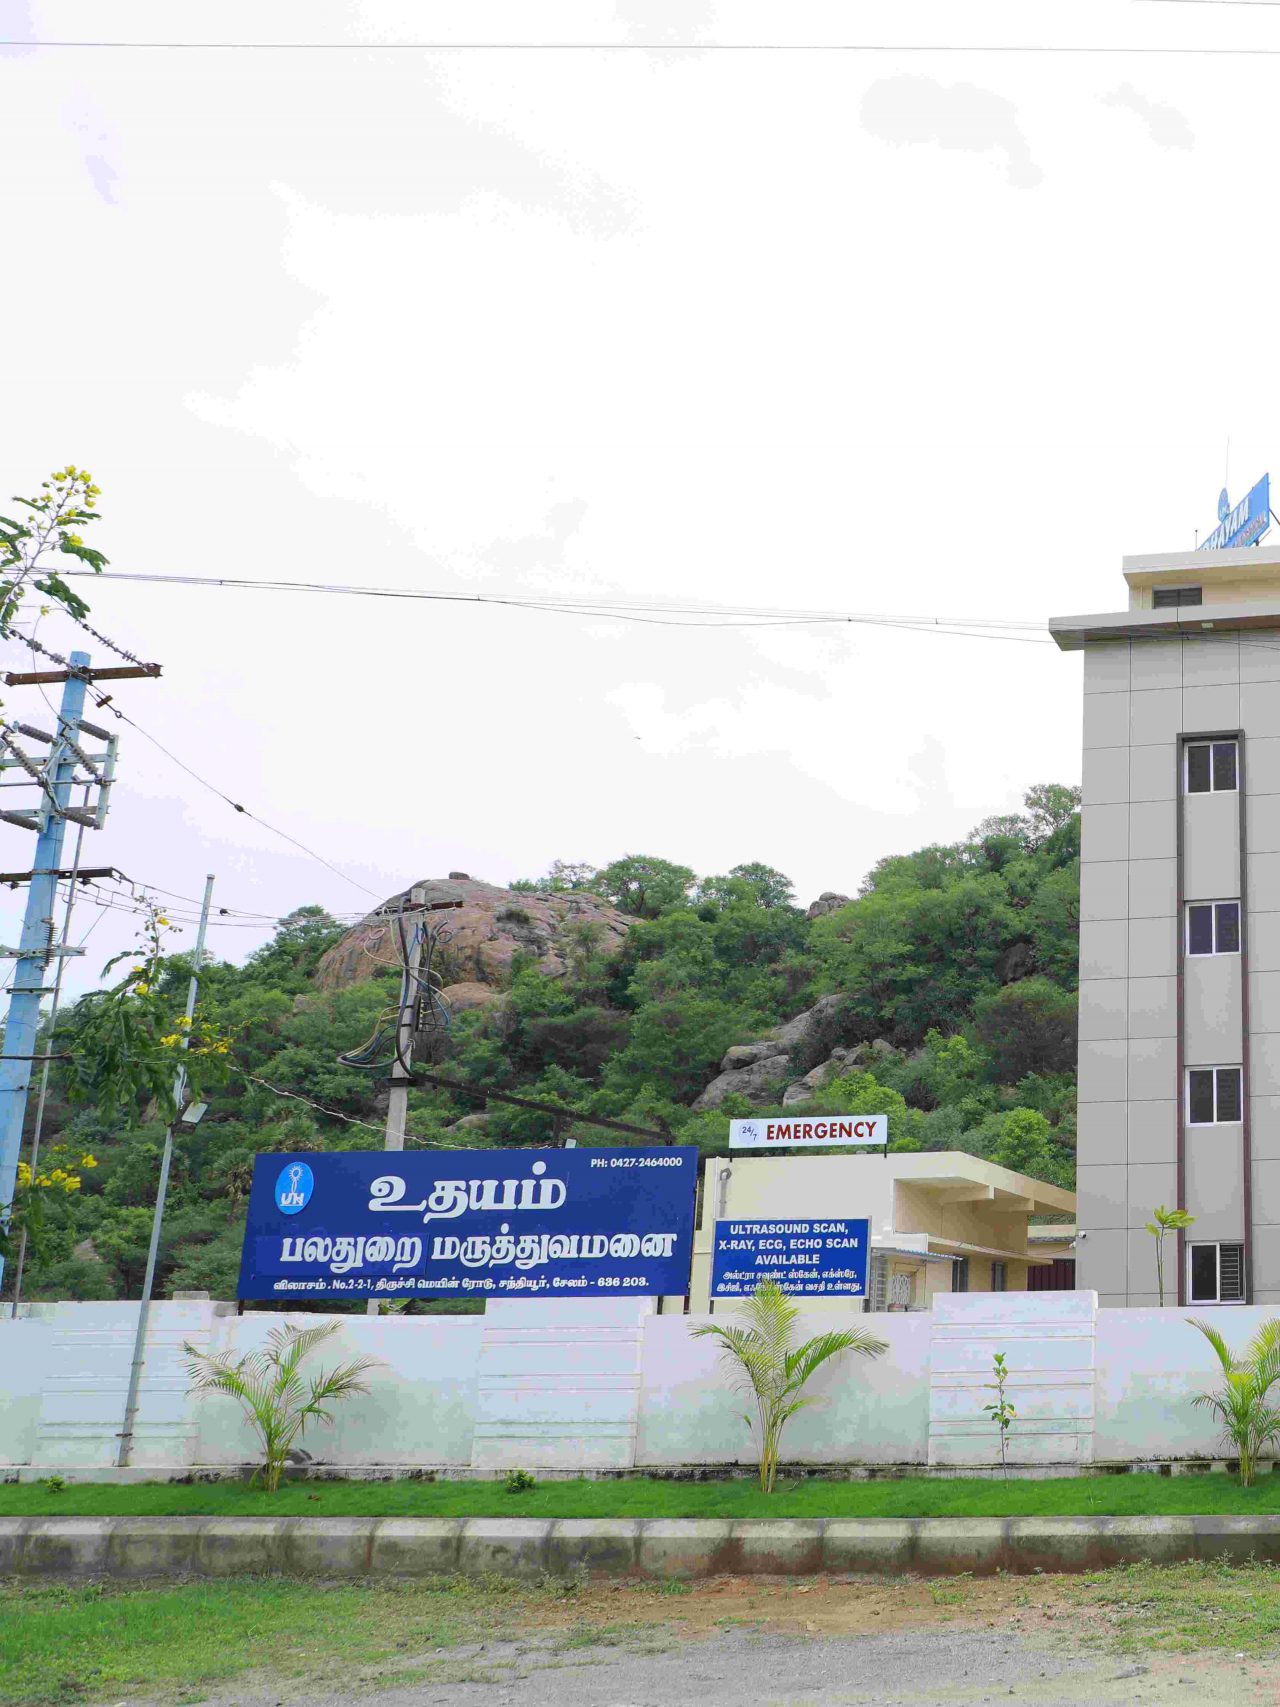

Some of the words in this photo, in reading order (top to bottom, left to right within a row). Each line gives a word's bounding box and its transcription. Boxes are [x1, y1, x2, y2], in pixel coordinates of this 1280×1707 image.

[742, 1126, 757, 1141] 24/7
[767, 1122, 877, 1140] EMERGENCY
[591, 1158, 608, 1168] PH:
[610, 1157, 683, 1168] 0427-2464000
[368, 1161, 566, 1224] உதயம்
[730, 1224, 809, 1234] ULTRASOUND
[812, 1223, 848, 1234] SCAN,
[280, 1234, 423, 1273] பலதுறை
[431, 1223, 678, 1269] மருத்துவமனை
[718, 1240, 755, 1251] X-RAY,
[758, 1239, 786, 1251] ECG,
[789, 1238, 822, 1249] ECHO
[826, 1238, 858, 1248] SCAN
[755, 1254, 820, 1265] AVAILABLE
[552, 1275, 587, 1288] சேலம்
[598, 1277, 620, 1287] 636
[622, 1276, 649, 1287] 203.
